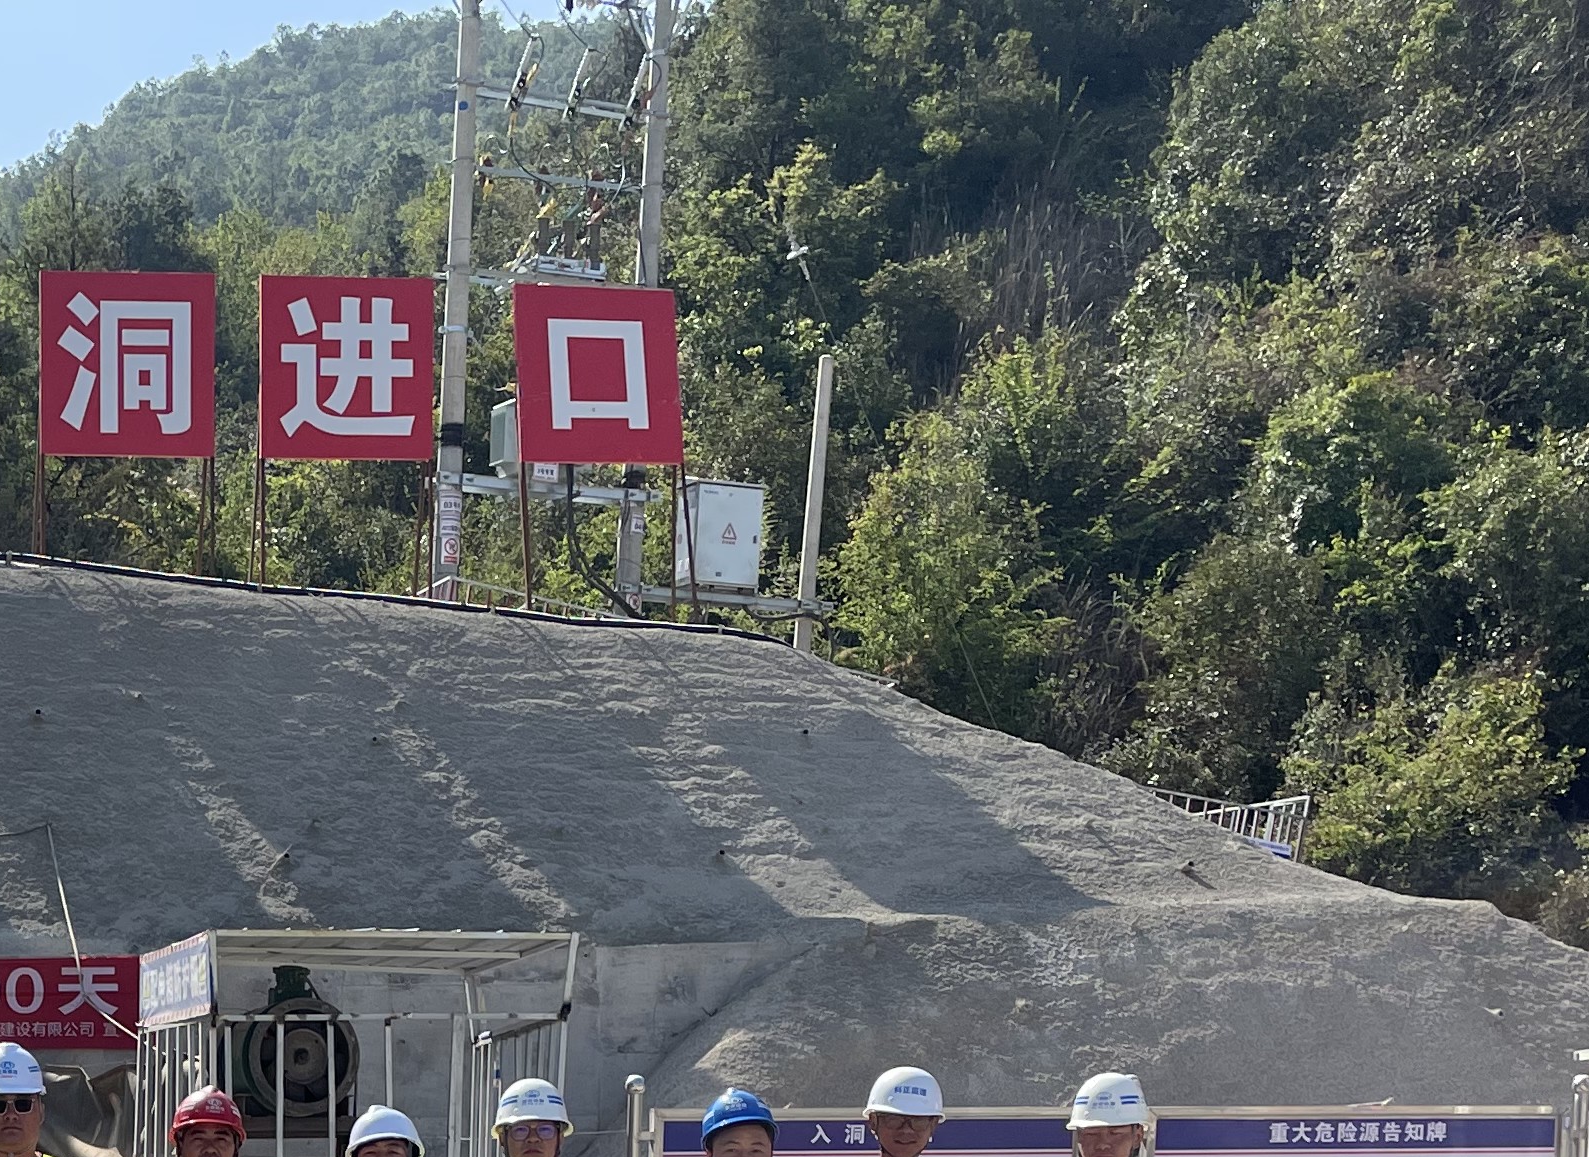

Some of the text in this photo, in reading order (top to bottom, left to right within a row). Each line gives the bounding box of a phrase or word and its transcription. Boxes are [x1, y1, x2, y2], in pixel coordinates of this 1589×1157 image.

[1269, 1121, 1448, 1143] 重大危险源告知牌
